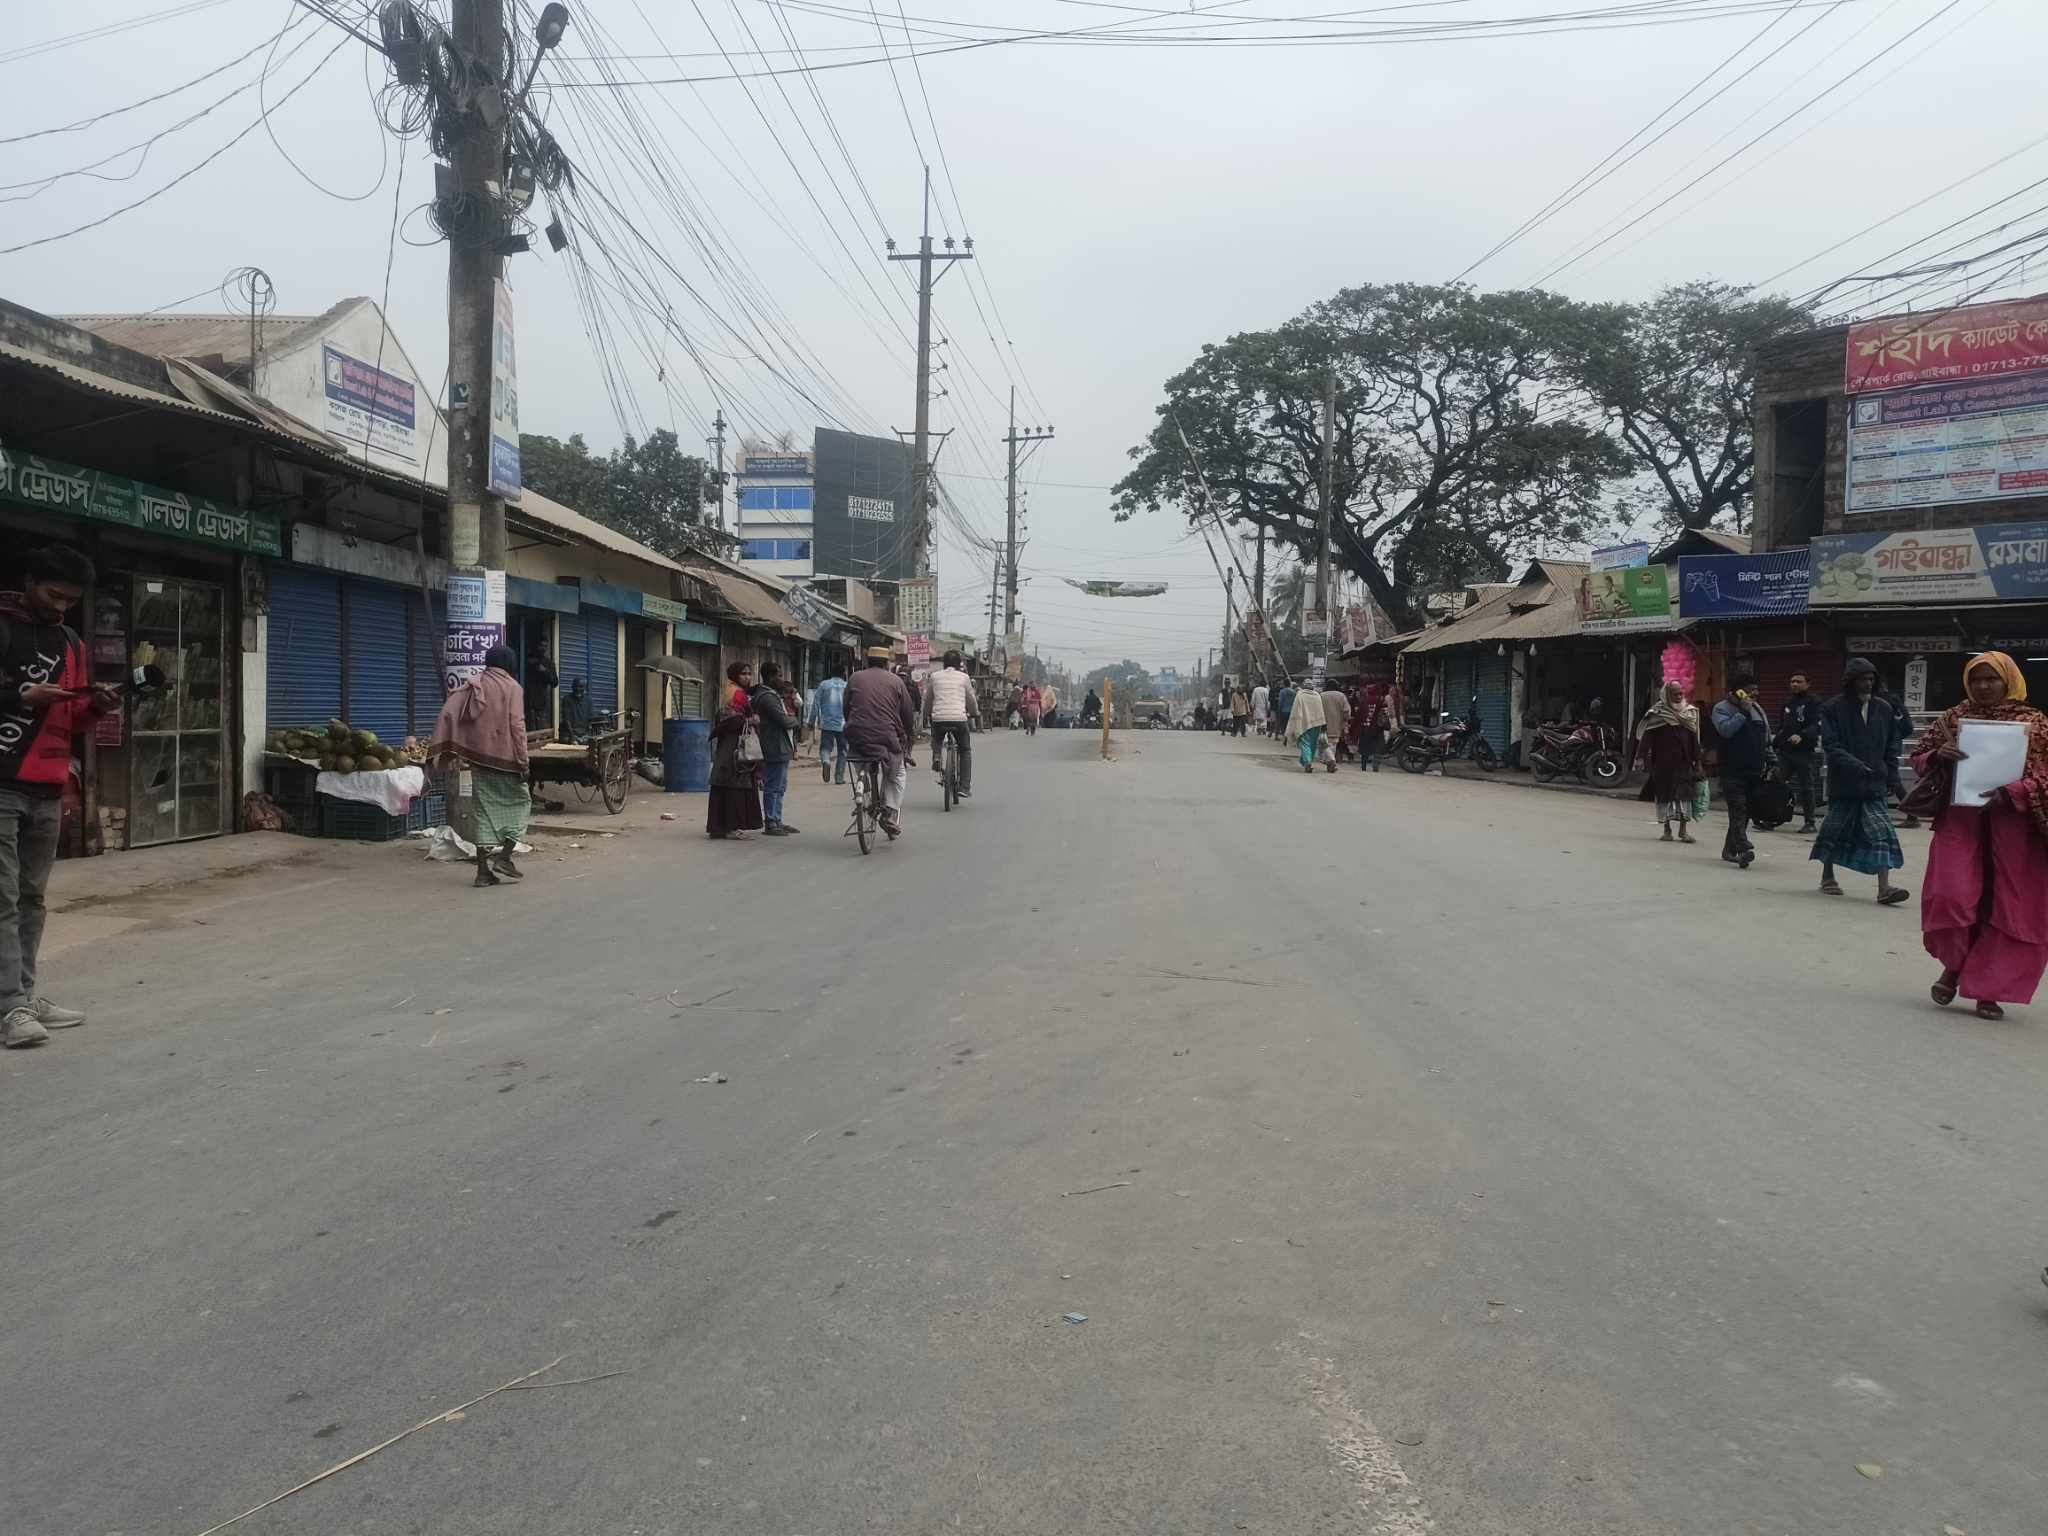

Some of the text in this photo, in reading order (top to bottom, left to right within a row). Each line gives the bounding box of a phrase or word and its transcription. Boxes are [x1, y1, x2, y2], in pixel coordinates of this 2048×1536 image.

[1855, 324, 1960, 367] শহীদ
[1961, 321, 2021, 350] ক্যাডেট
[20, 456, 91, 509] ট্রেডার্স
[196, 500, 249, 545] ট্রেডার্স
[1873, 538, 1973, 571] গাইবান্ধা
